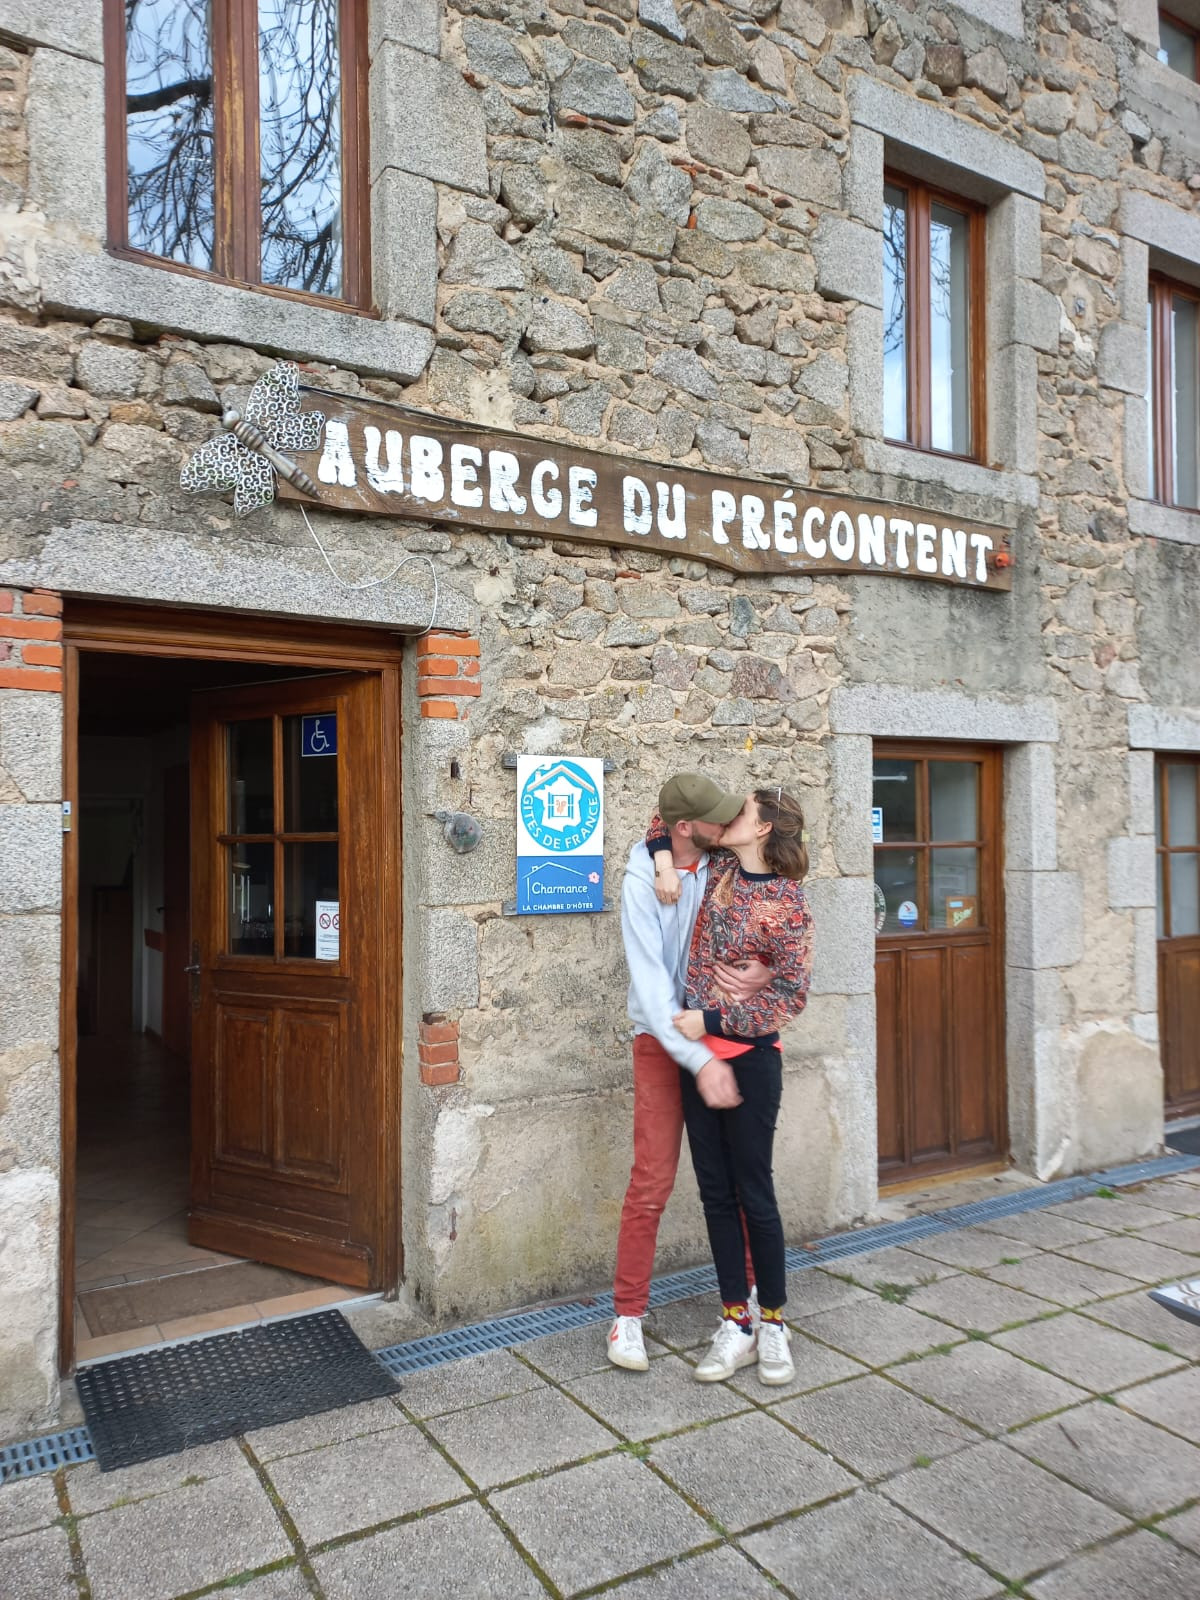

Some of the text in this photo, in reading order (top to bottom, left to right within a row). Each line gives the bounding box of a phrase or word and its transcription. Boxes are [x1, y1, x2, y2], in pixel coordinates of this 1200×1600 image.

[317, 418, 993, 583] AUBERGE DU PRÉCONTENT
[543, 834, 561, 849] DE
[565, 797, 598, 848] FRANCE
[531, 882, 588, 894] Charmance
